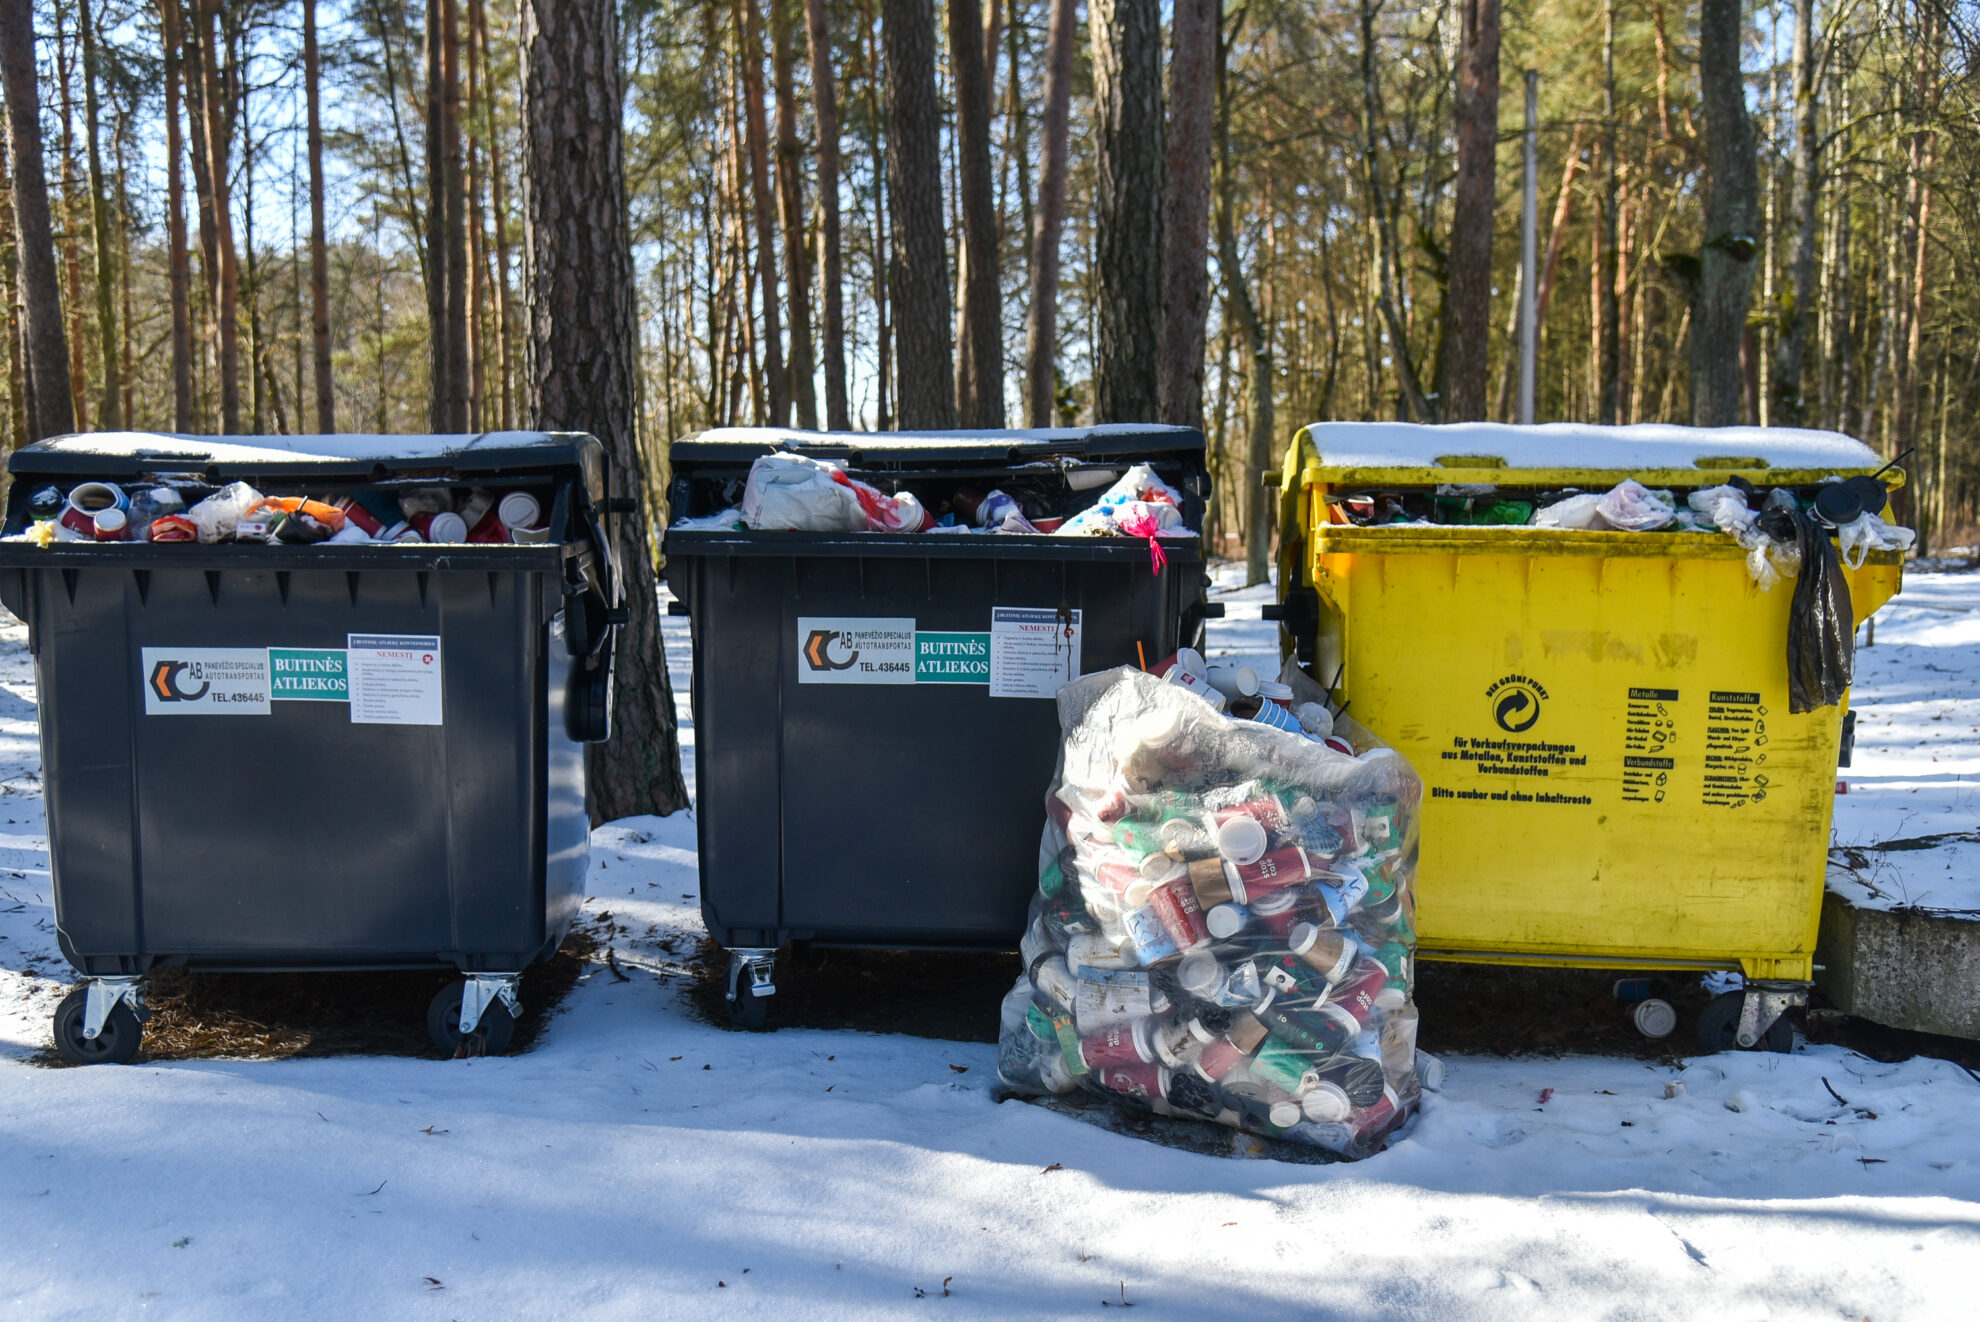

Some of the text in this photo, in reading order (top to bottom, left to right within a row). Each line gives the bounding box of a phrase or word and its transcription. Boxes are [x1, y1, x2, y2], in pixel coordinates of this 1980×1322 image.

[840, 631, 852, 649] AB
[884, 631, 911, 639] SPECIALUS
[855, 642, 911, 650] AUTOTRANSPORTAS
[920, 639, 986, 655] BUITINĖS
[189, 662, 203, 680] AB
[275, 656, 343, 673] BUITINĖS
[917, 660, 988, 673] ATLIEKOS
[205, 672, 265, 680] AUTOTRANSPORTAS
[273, 677, 347, 691] ATLIEKOS
[1486, 674, 1549, 700] DER GRÜNE PUNKT
[1631, 689, 1658, 698] Metalle
[1711, 693, 1755, 703] Kunststoffe
[1454, 737, 1575, 754] für Verkaufsverpackungen
[1442, 750, 1586, 765] aus Metallen, Kunststoffen und
[1626, 758, 1672, 768] Verbundstoffe
[1478, 763, 1548, 776] Verbundstoffen
[1432, 787, 1591, 805] Bitte sauber und ohne Inhaltsreste
[1259, 860, 1270, 878] stop
[1267, 859, 1282, 876] cafe
